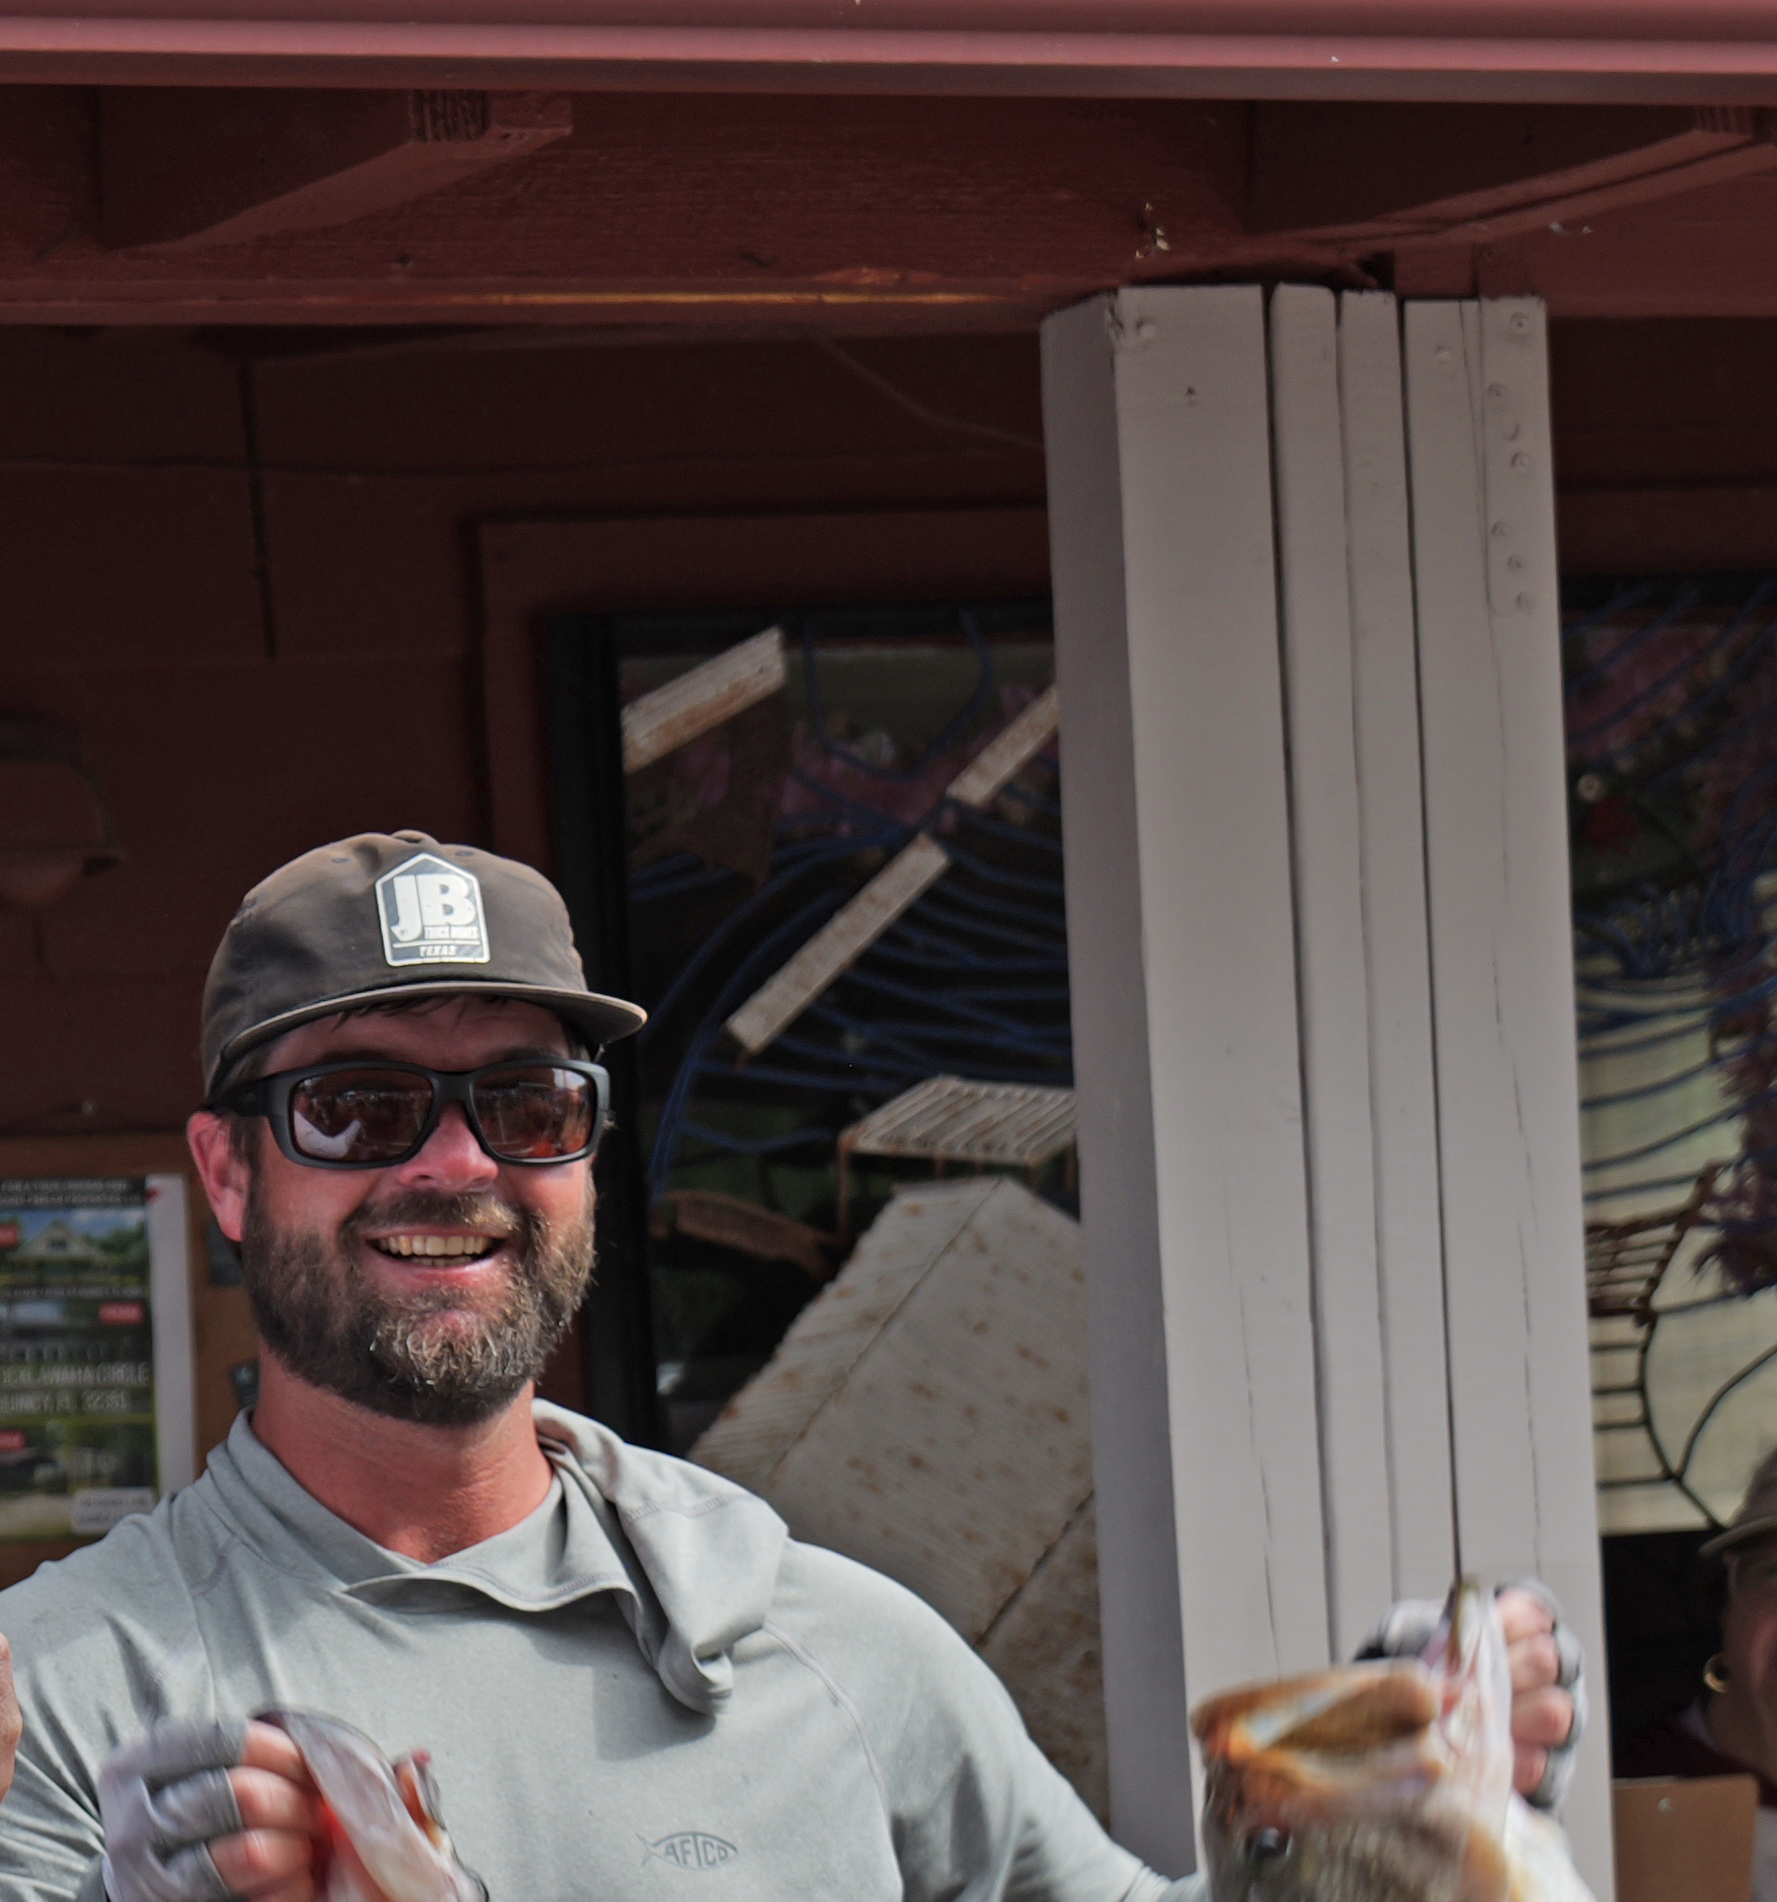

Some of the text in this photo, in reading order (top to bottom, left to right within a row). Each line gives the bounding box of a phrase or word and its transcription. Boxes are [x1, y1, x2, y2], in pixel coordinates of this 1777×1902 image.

[389, 874, 477, 942] JB
[419, 945, 457, 957] TEXAS
[662, 1832, 729, 1867] AFTCO
